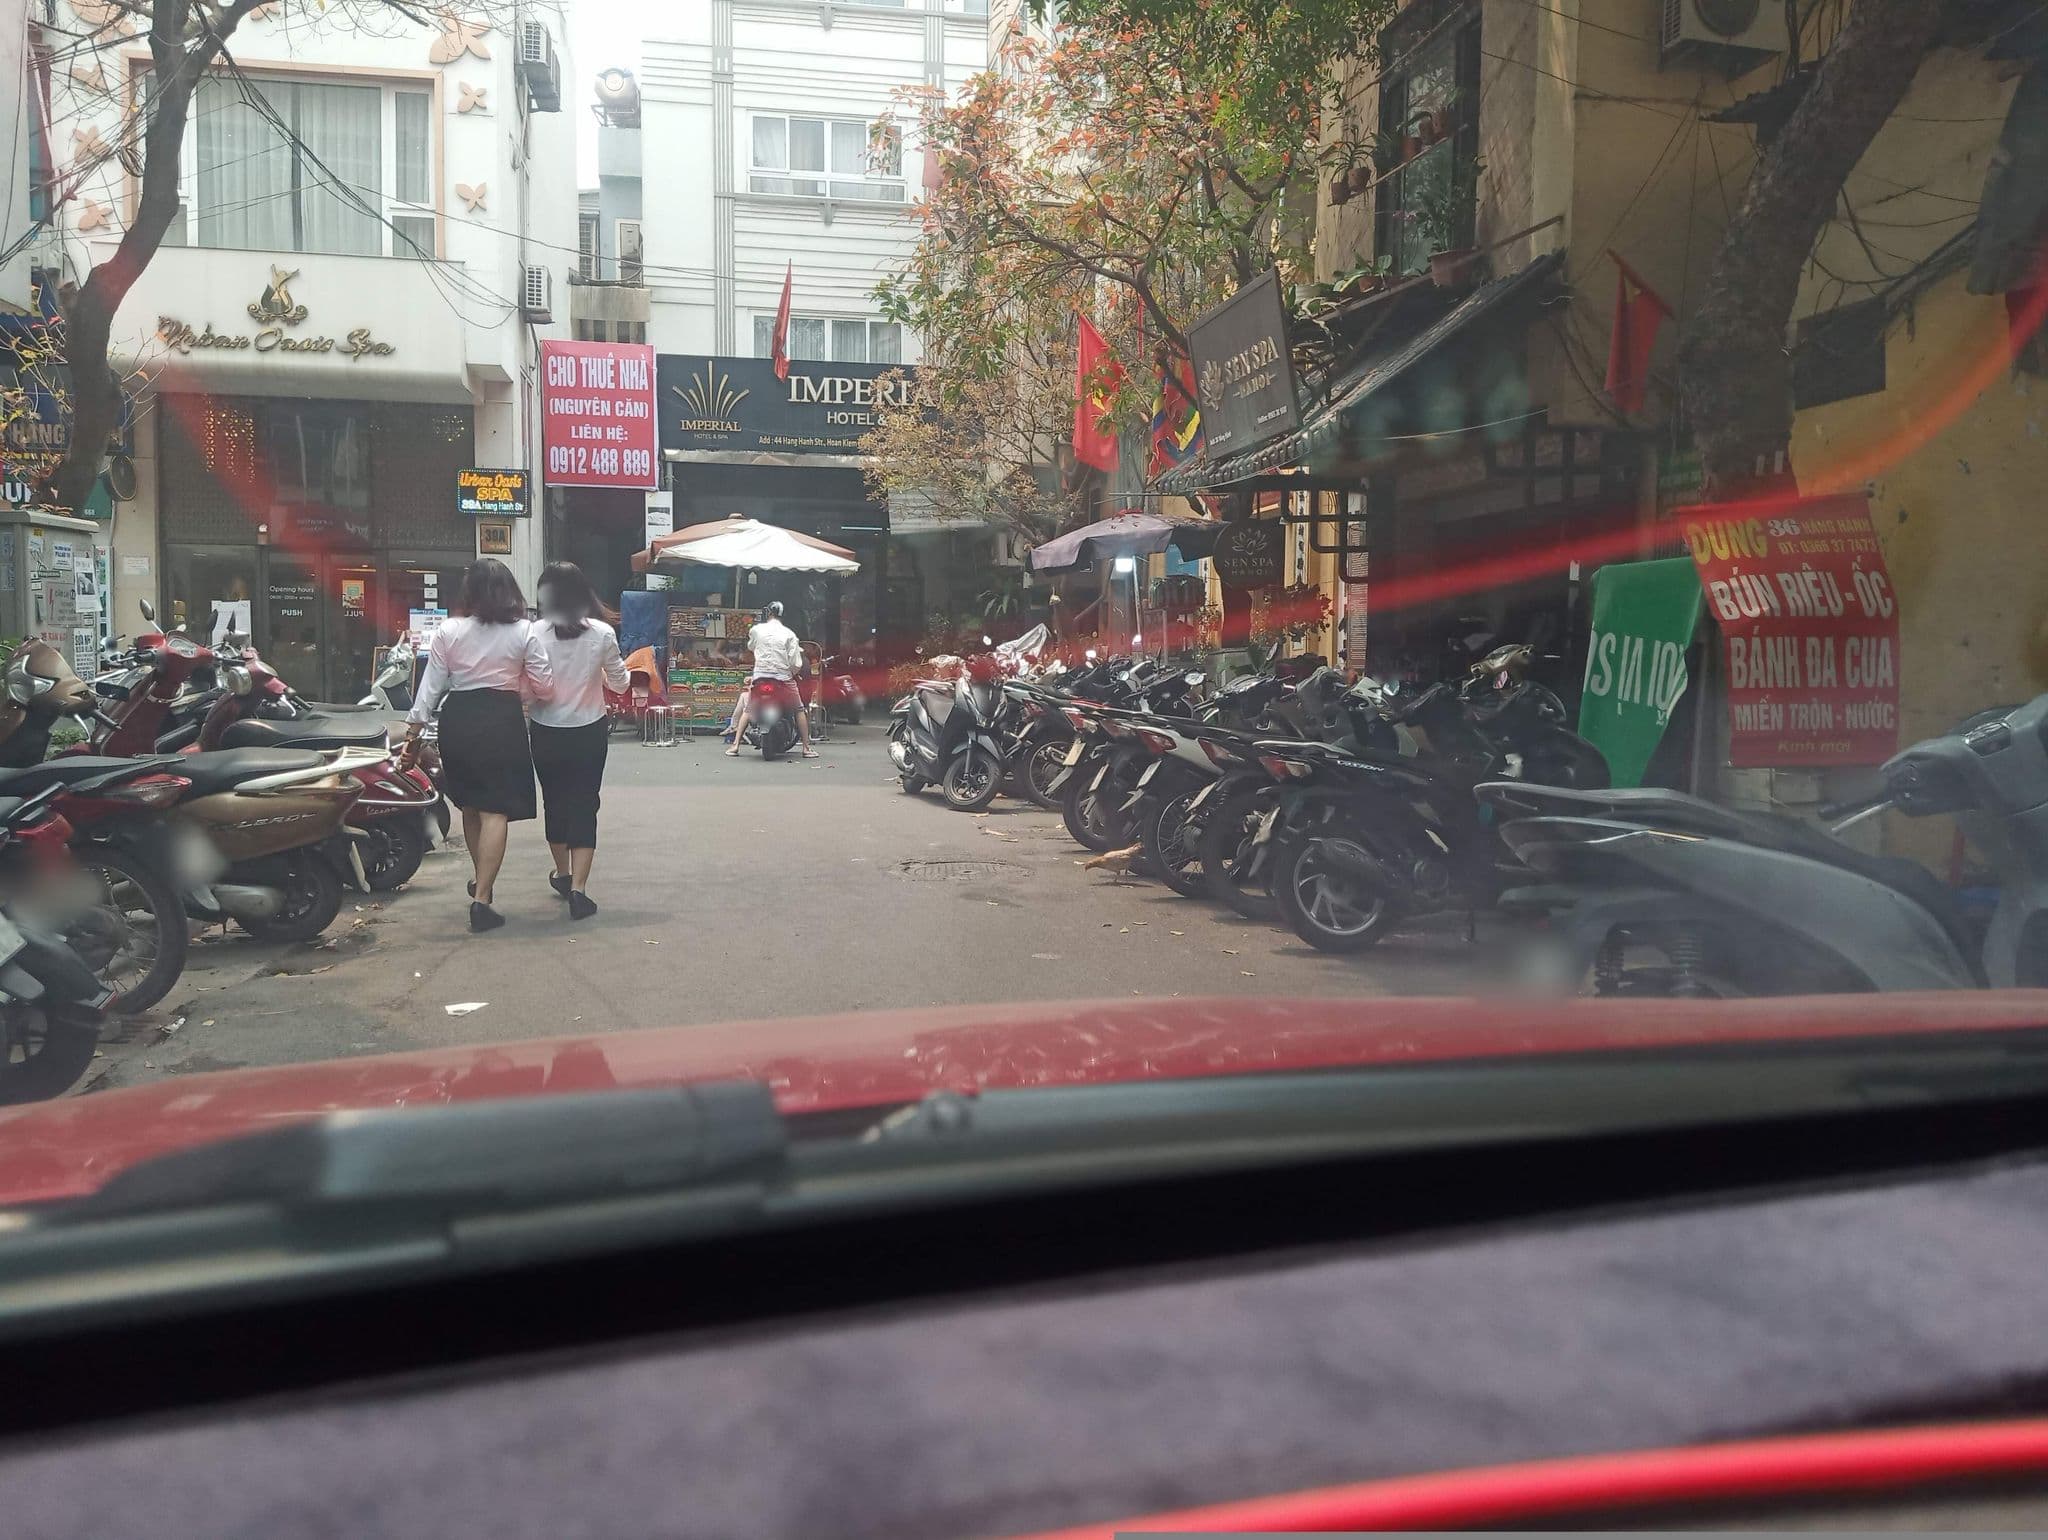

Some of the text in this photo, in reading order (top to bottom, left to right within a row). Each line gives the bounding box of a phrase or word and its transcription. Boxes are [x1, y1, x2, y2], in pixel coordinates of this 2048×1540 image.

[254, 327, 335, 352] Oasis
[336, 328, 396, 362] Spa
[1250, 336, 1280, 373] SPA
[547, 352, 649, 390] CHO THUÊ NHÀ
[549, 397, 649, 420] (NGUYÊN CĂN)
[680, 419, 742, 432] IMPERIAL
[826, 411, 875, 426] HOTEL
[877, 413, 886, 426] &
[571, 424, 629, 443] LIÊN HỆ:
[758, 436, 771, 444] Add
[774, 436, 782, 444] 44
[783, 437, 798, 447] Hang
[799, 437, 814, 446] Hanh
[826, 438, 842, 446] Hoan
[843, 438, 858, 447] Kiem
[550, 446, 650, 477] 0912 488 889
[459, 472, 523, 488] Urban Oasis
[477, 487, 513, 501] SPA
[482, 502, 498, 511] Hang
[498, 502, 514, 510] Hanh
[1767, 518, 1800, 536] 36
[1224, 557, 1274, 567] SEN SPA
[269, 585, 314, 594] Opening hours
[1709, 566, 1781, 621] BÚN
[1852, 556, 1893, 618] ỐC
[281, 609, 303, 617] PUSH
[1730, 626, 1894, 689] BÁNH ĐA CUA
[1734, 694, 1783, 731] MIẾN
[1790, 698, 1833, 736] TRỘN
[1846, 695, 1895, 729] NƯỚC
